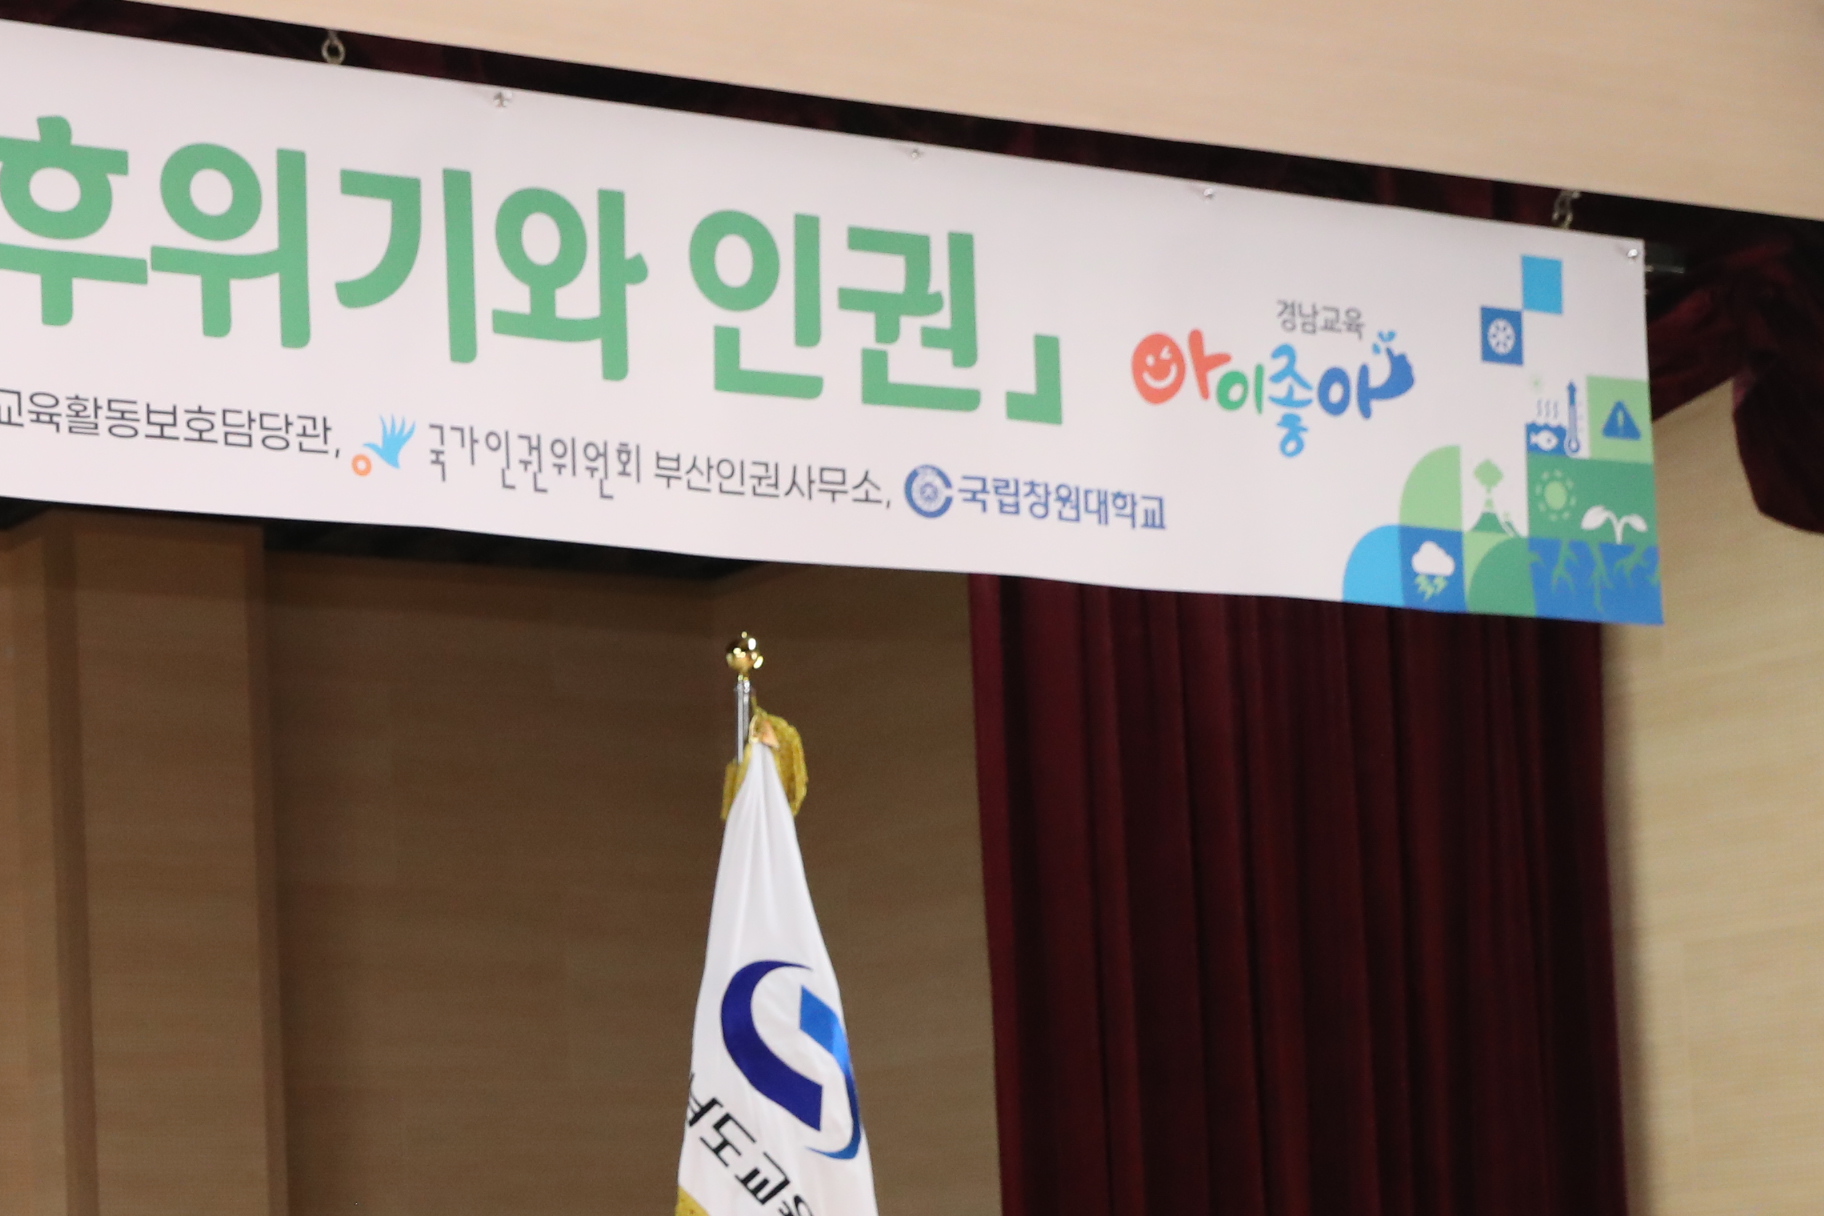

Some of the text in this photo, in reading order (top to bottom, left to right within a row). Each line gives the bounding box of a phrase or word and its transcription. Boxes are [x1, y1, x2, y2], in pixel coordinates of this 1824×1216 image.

[1276, 300, 1364, 340] 경남교육
[1131, 328, 1415, 459] 아이좋아
[428, 422, 892, 511] 국가인권위원회 부산인권사무소,
[957, 474, 1167, 531] 국립창원대학교
